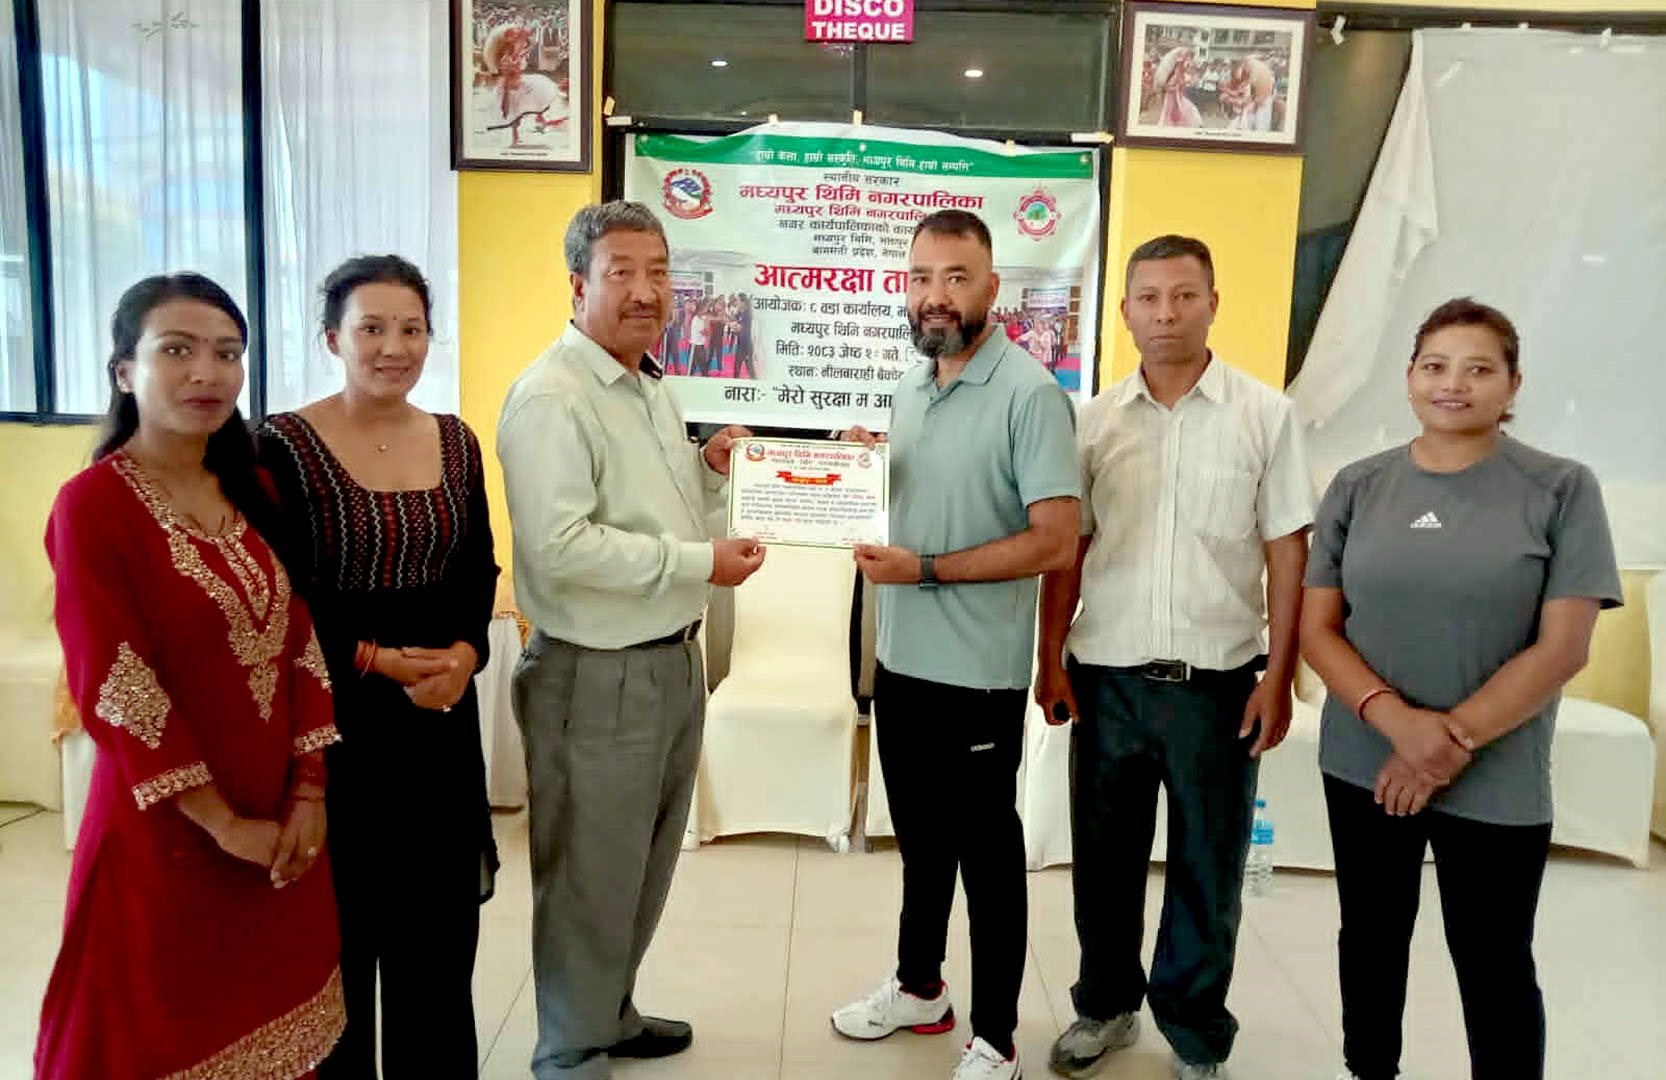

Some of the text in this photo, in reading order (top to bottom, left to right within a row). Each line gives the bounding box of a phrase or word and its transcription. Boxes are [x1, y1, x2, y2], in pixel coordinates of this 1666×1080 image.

[814, 0, 904, 17] DISCO
[812, 21, 905, 41] THEQUE
[738, 183, 984, 209] मध्यपुर थिमि नगरपालिका
[866, 207, 928, 221] नगरपालि
[754, 263, 875, 294] आत्मरक्षा
[791, 320, 912, 341] मध्यपुर थिमि नगरपालि
[776, 339, 804, 356] मिति:
[809, 389, 851, 411] सुरक्षा
[874, 393, 893, 409] आ
